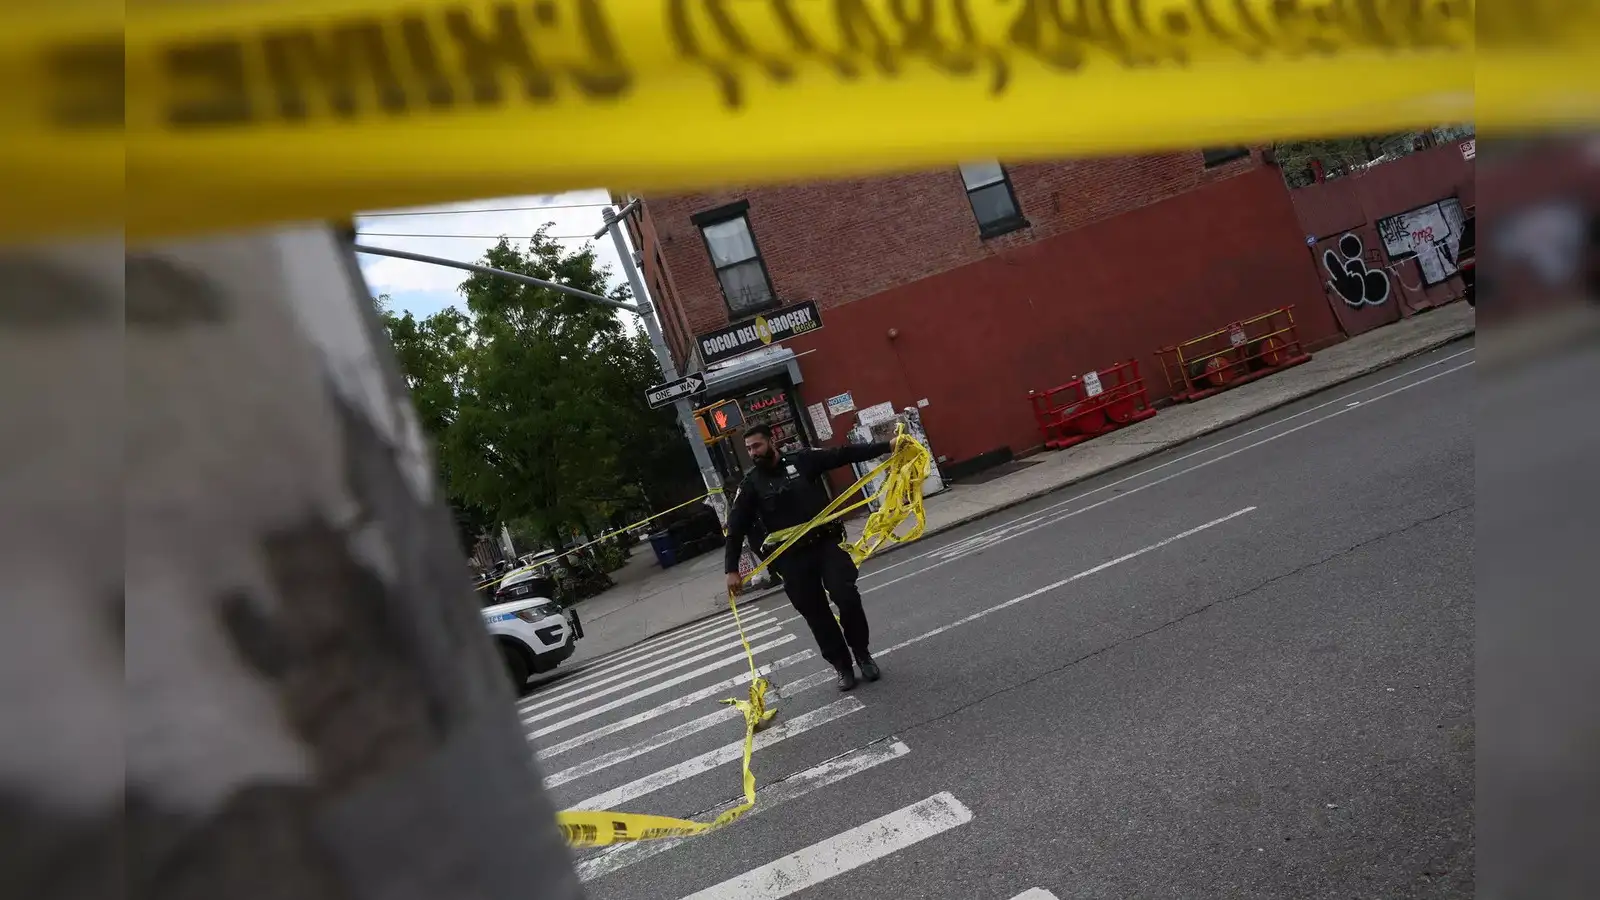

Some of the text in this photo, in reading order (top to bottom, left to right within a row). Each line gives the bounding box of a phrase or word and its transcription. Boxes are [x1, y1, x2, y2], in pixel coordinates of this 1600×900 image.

[702, 331, 739, 356] COCOA
[736, 323, 760, 344] DELI
[767, 307, 812, 334] GROCERY
[655, 380, 696, 400] ONE WAY
[828, 394, 851, 406] NOTICE
